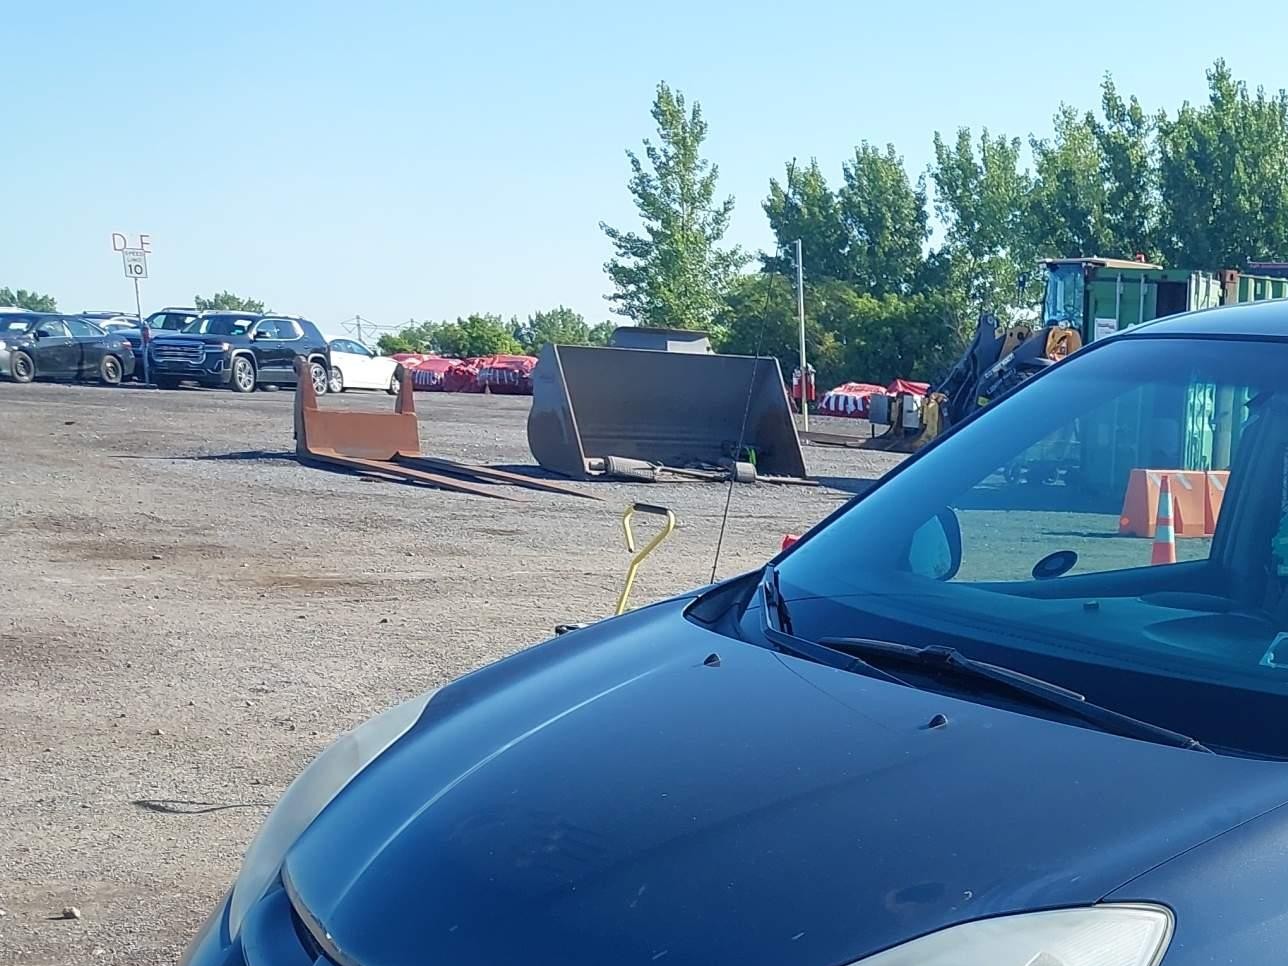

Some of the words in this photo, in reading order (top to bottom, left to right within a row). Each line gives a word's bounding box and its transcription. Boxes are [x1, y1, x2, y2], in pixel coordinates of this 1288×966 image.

[112, 232, 127, 252] D
[140, 234, 152, 254] E
[128, 263, 144, 275] 10
